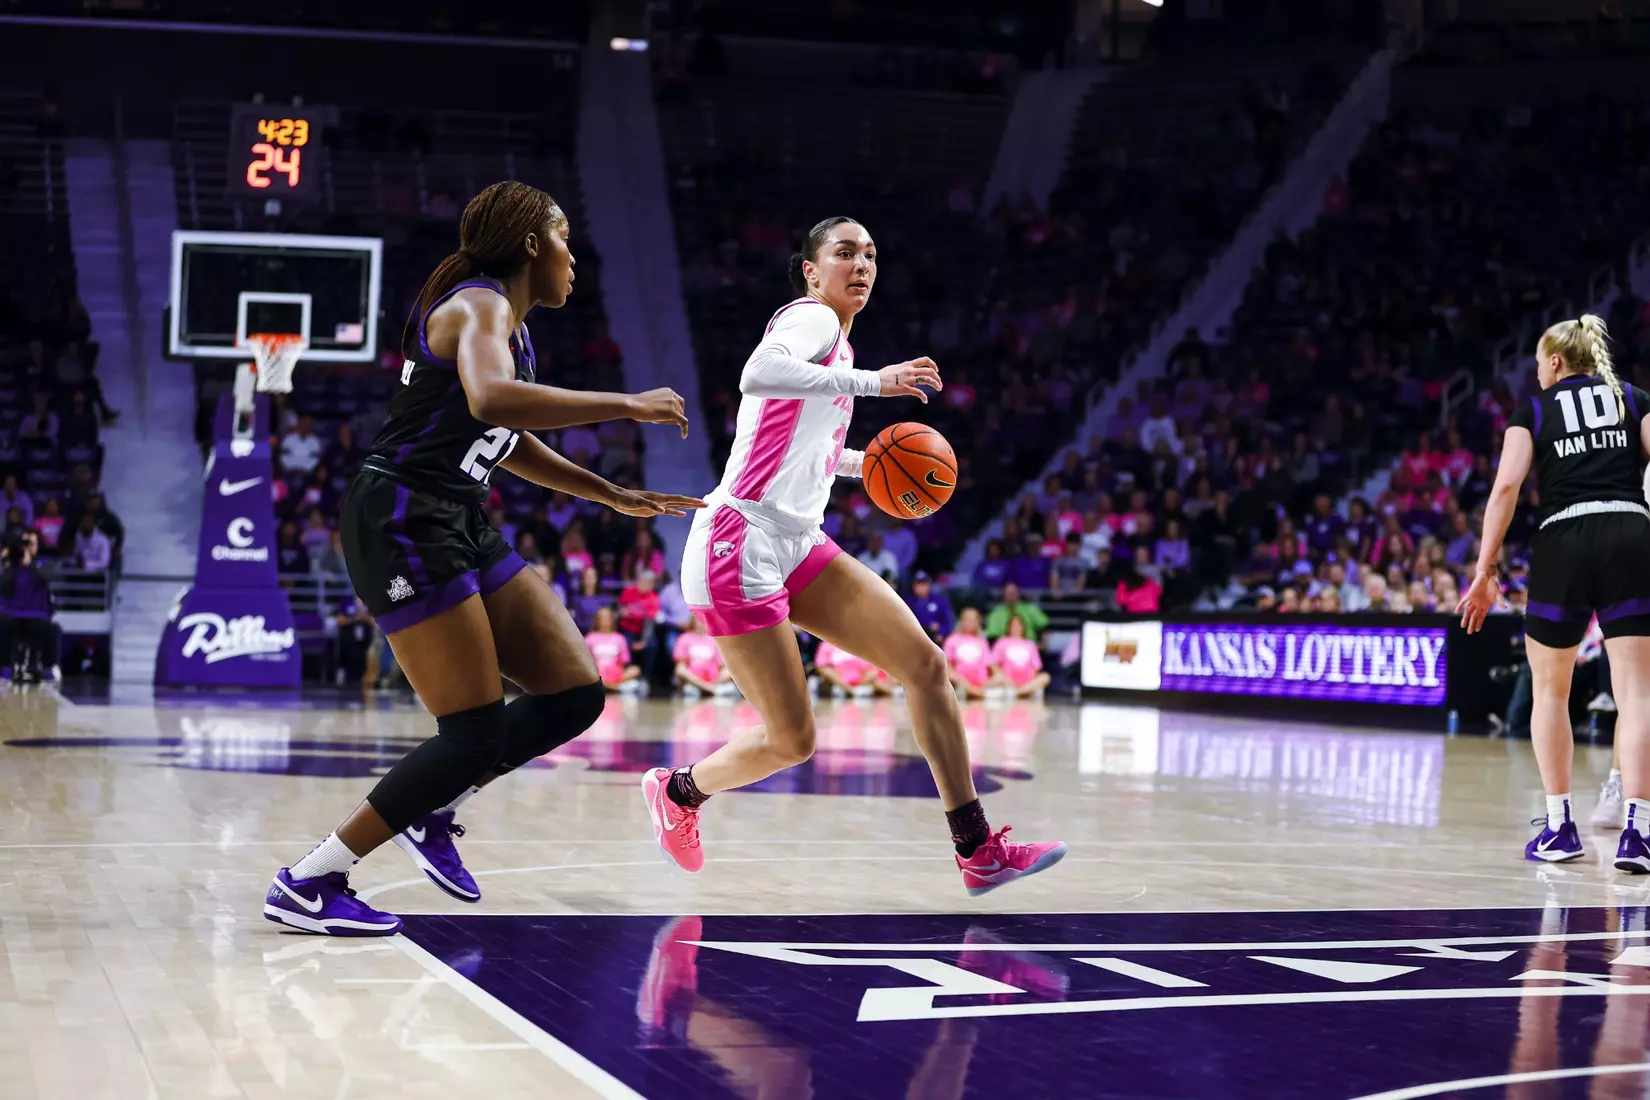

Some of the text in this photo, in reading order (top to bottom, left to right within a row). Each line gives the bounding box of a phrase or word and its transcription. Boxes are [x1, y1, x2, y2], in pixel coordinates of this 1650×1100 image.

[258, 118, 309, 146] 4:23
[247, 143, 301, 188] 24
[1554, 384, 1620, 433] 10
[459, 426, 520, 485] 2
[1553, 430, 1628, 459] VAN LITH
[1163, 630, 1445, 688] KANSAS LOTTERY
